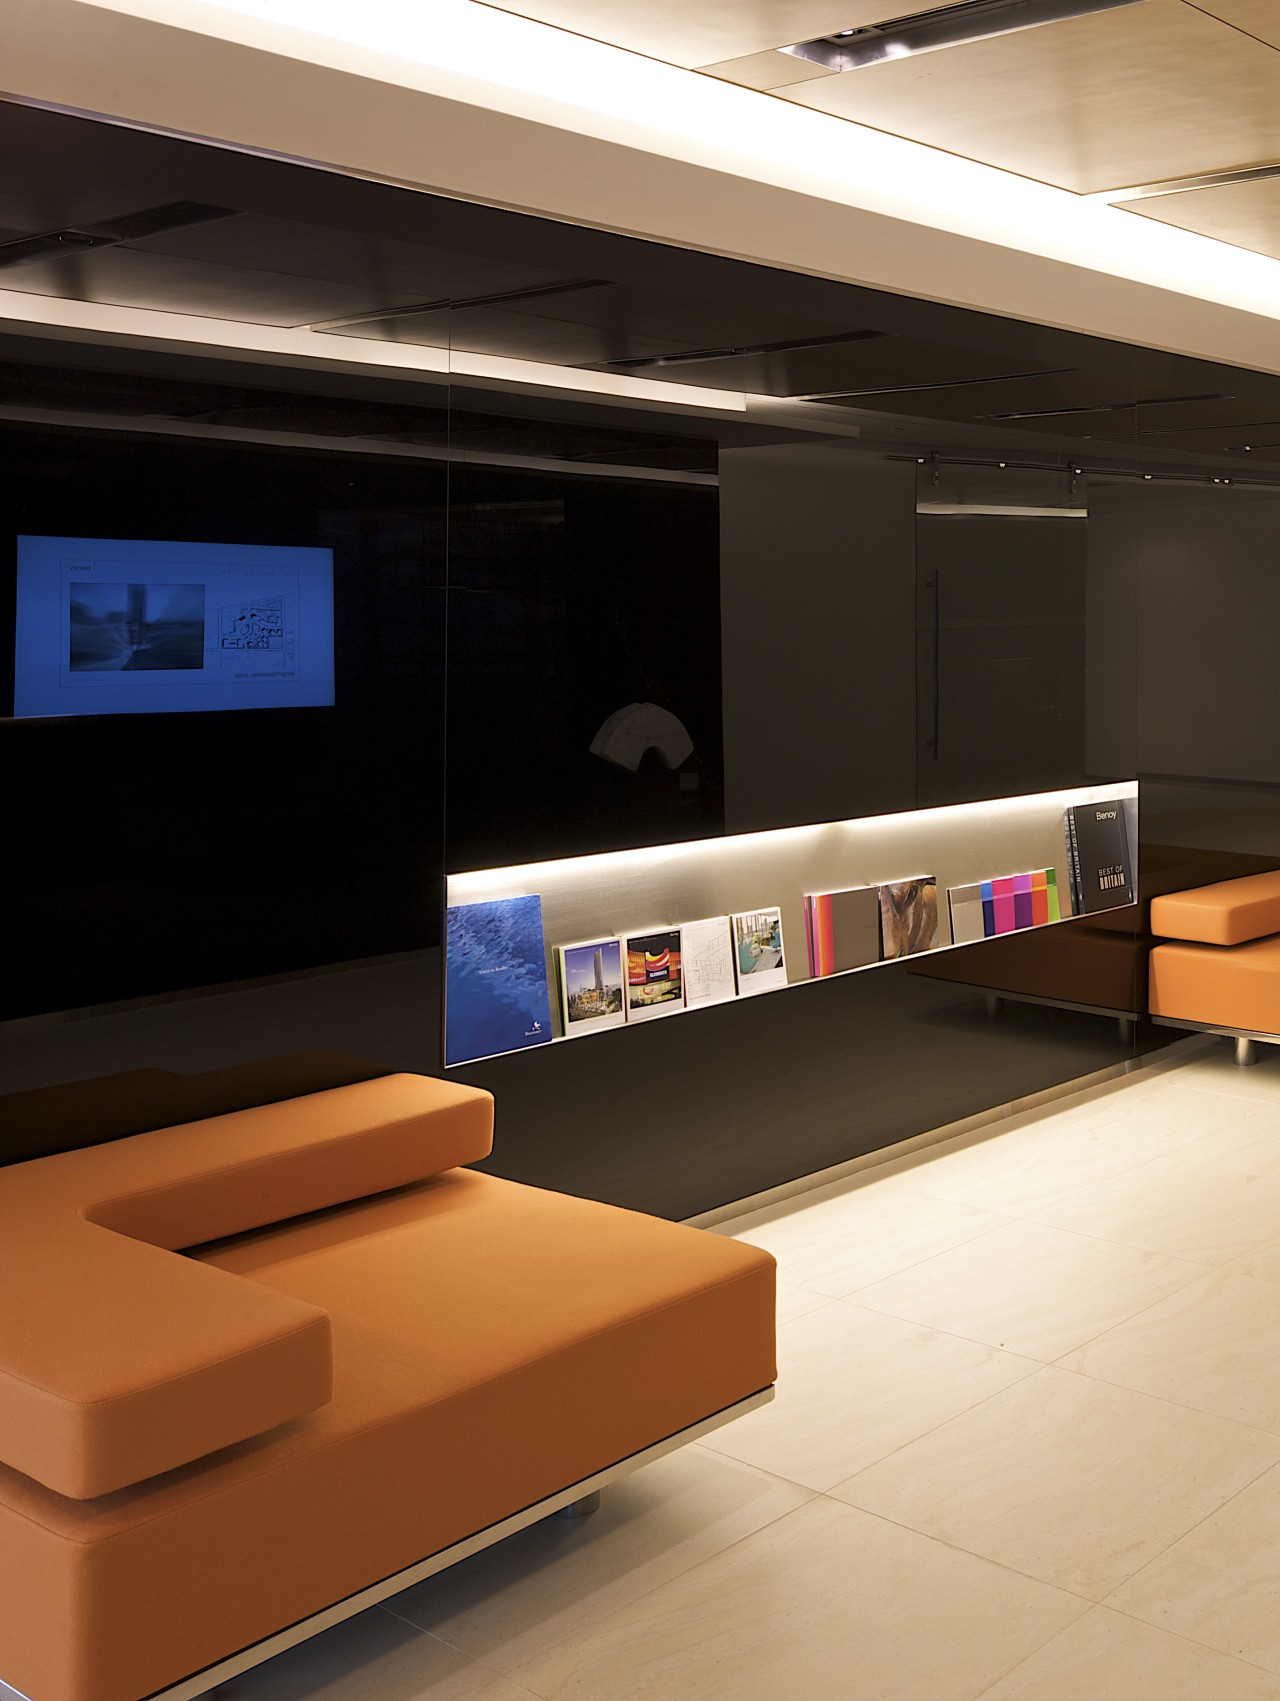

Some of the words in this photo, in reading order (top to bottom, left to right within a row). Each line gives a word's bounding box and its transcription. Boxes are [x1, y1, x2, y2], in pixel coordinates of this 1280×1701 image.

[1096, 811, 1117, 821] Benoy
[1072, 838, 1078, 848] OF
[1073, 851, 1081, 882] BRITAIN
[1099, 867, 1114, 877] BEST
[1116, 865, 1124, 873] OF
[1100, 873, 1125, 890] BRITAIN
